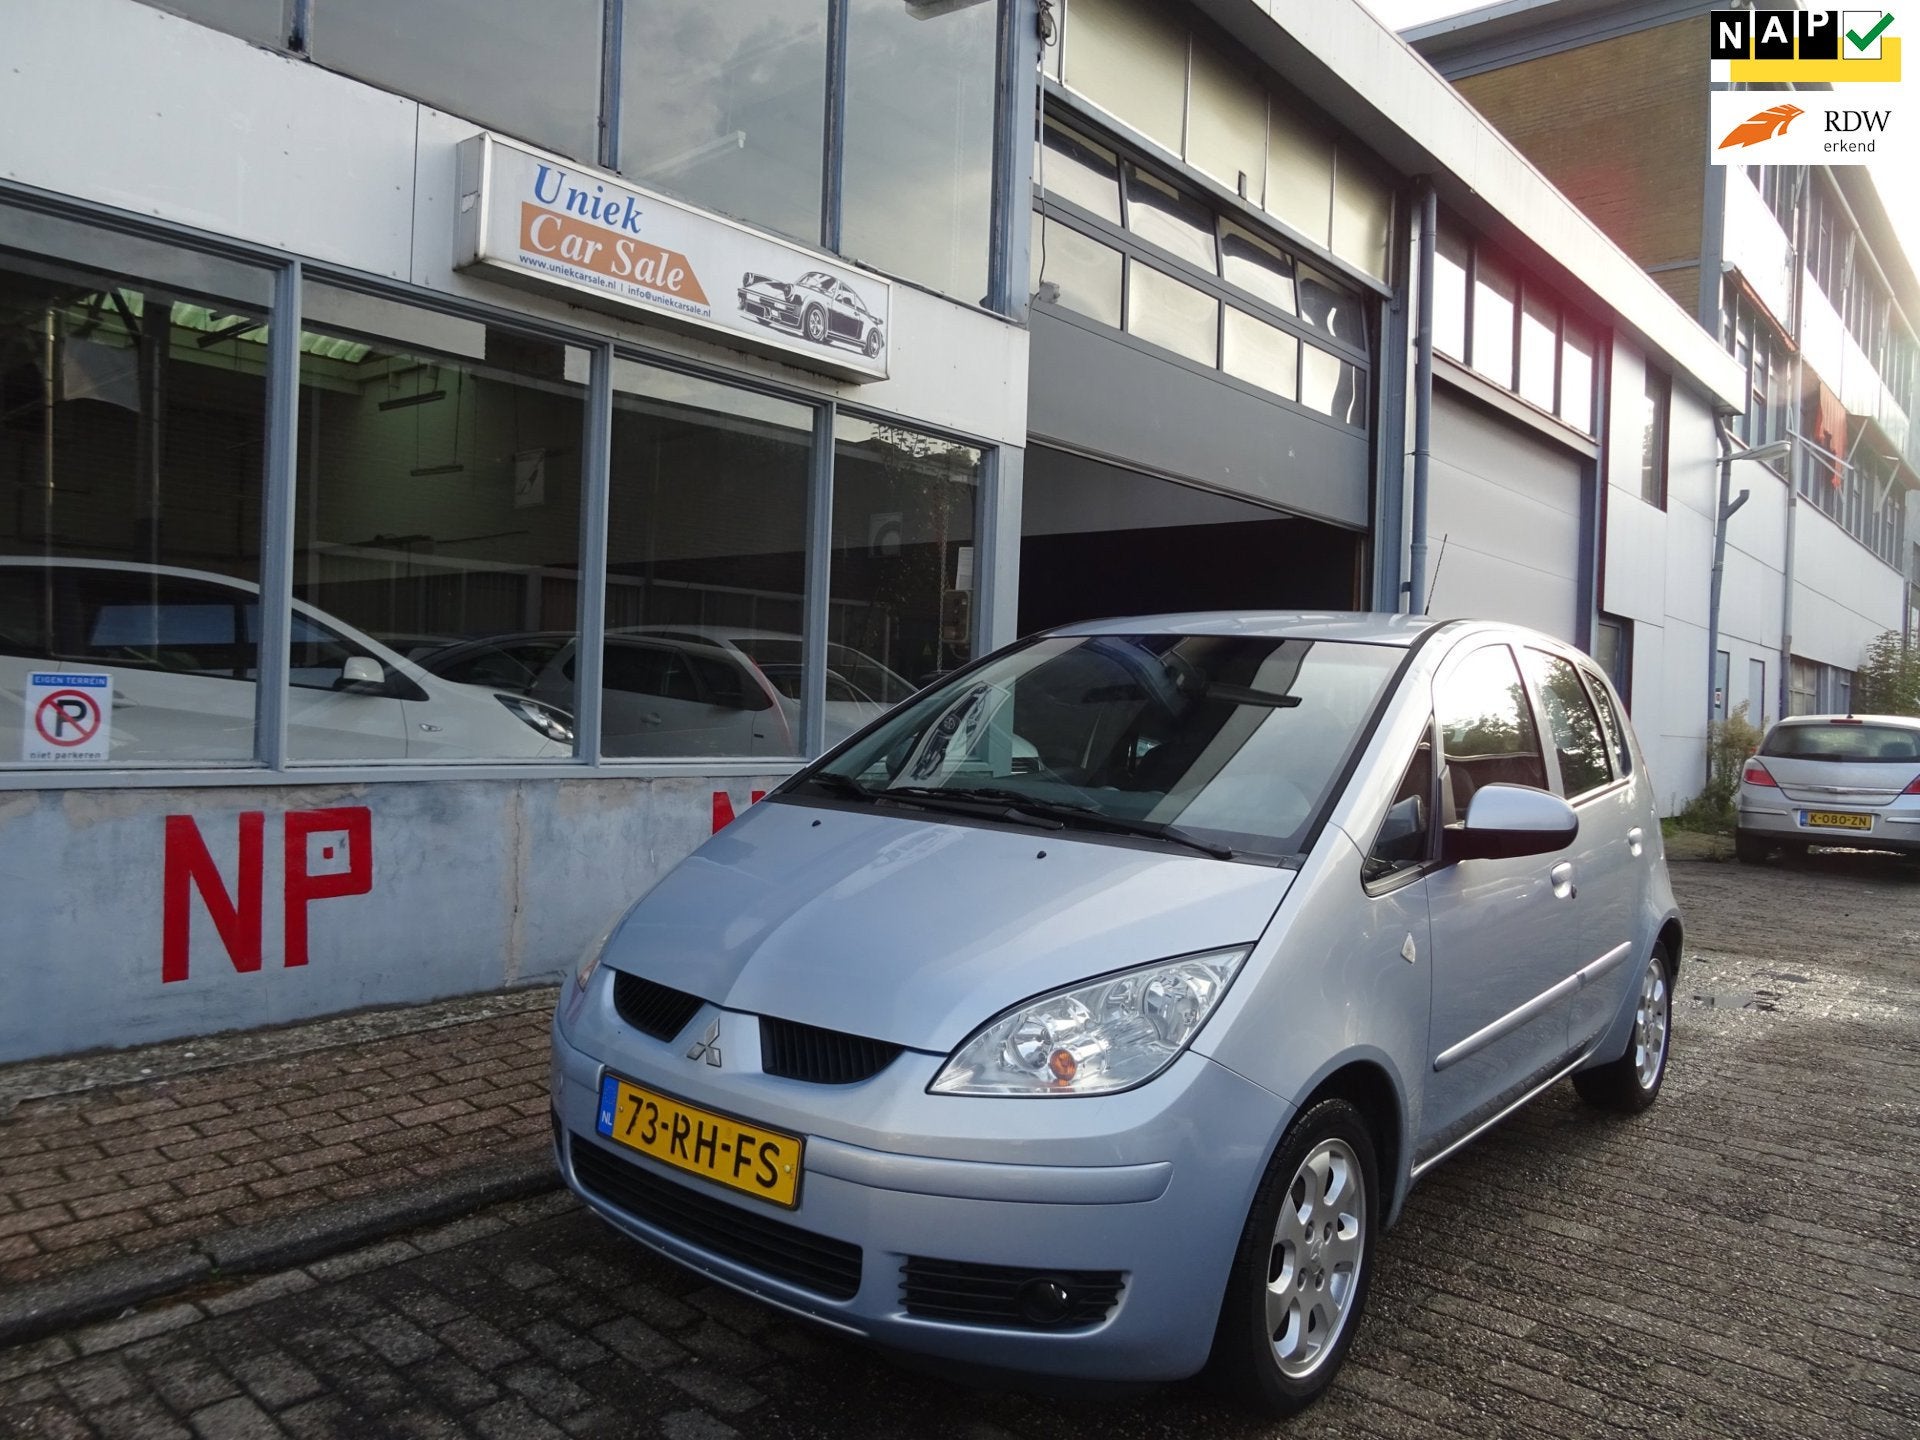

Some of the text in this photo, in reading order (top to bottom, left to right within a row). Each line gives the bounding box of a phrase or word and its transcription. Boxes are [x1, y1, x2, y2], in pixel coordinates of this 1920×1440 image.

[534, 163, 643, 234] Uniek
[530, 213, 684, 291] Car Sale
[519, 255, 711, 317] www.uniekcarsale.nl info@uniekcarsale.nl
[34, 675, 106, 685] EIGEN TERREIN
[30, 751, 102, 760] niet parkeren
[1810, 813, 1867, 826] K-080-ZN
[162, 806, 372, 983] NP
[601, 1110, 613, 1126] NL
[626, 1094, 780, 1188] 73-RH-FS
